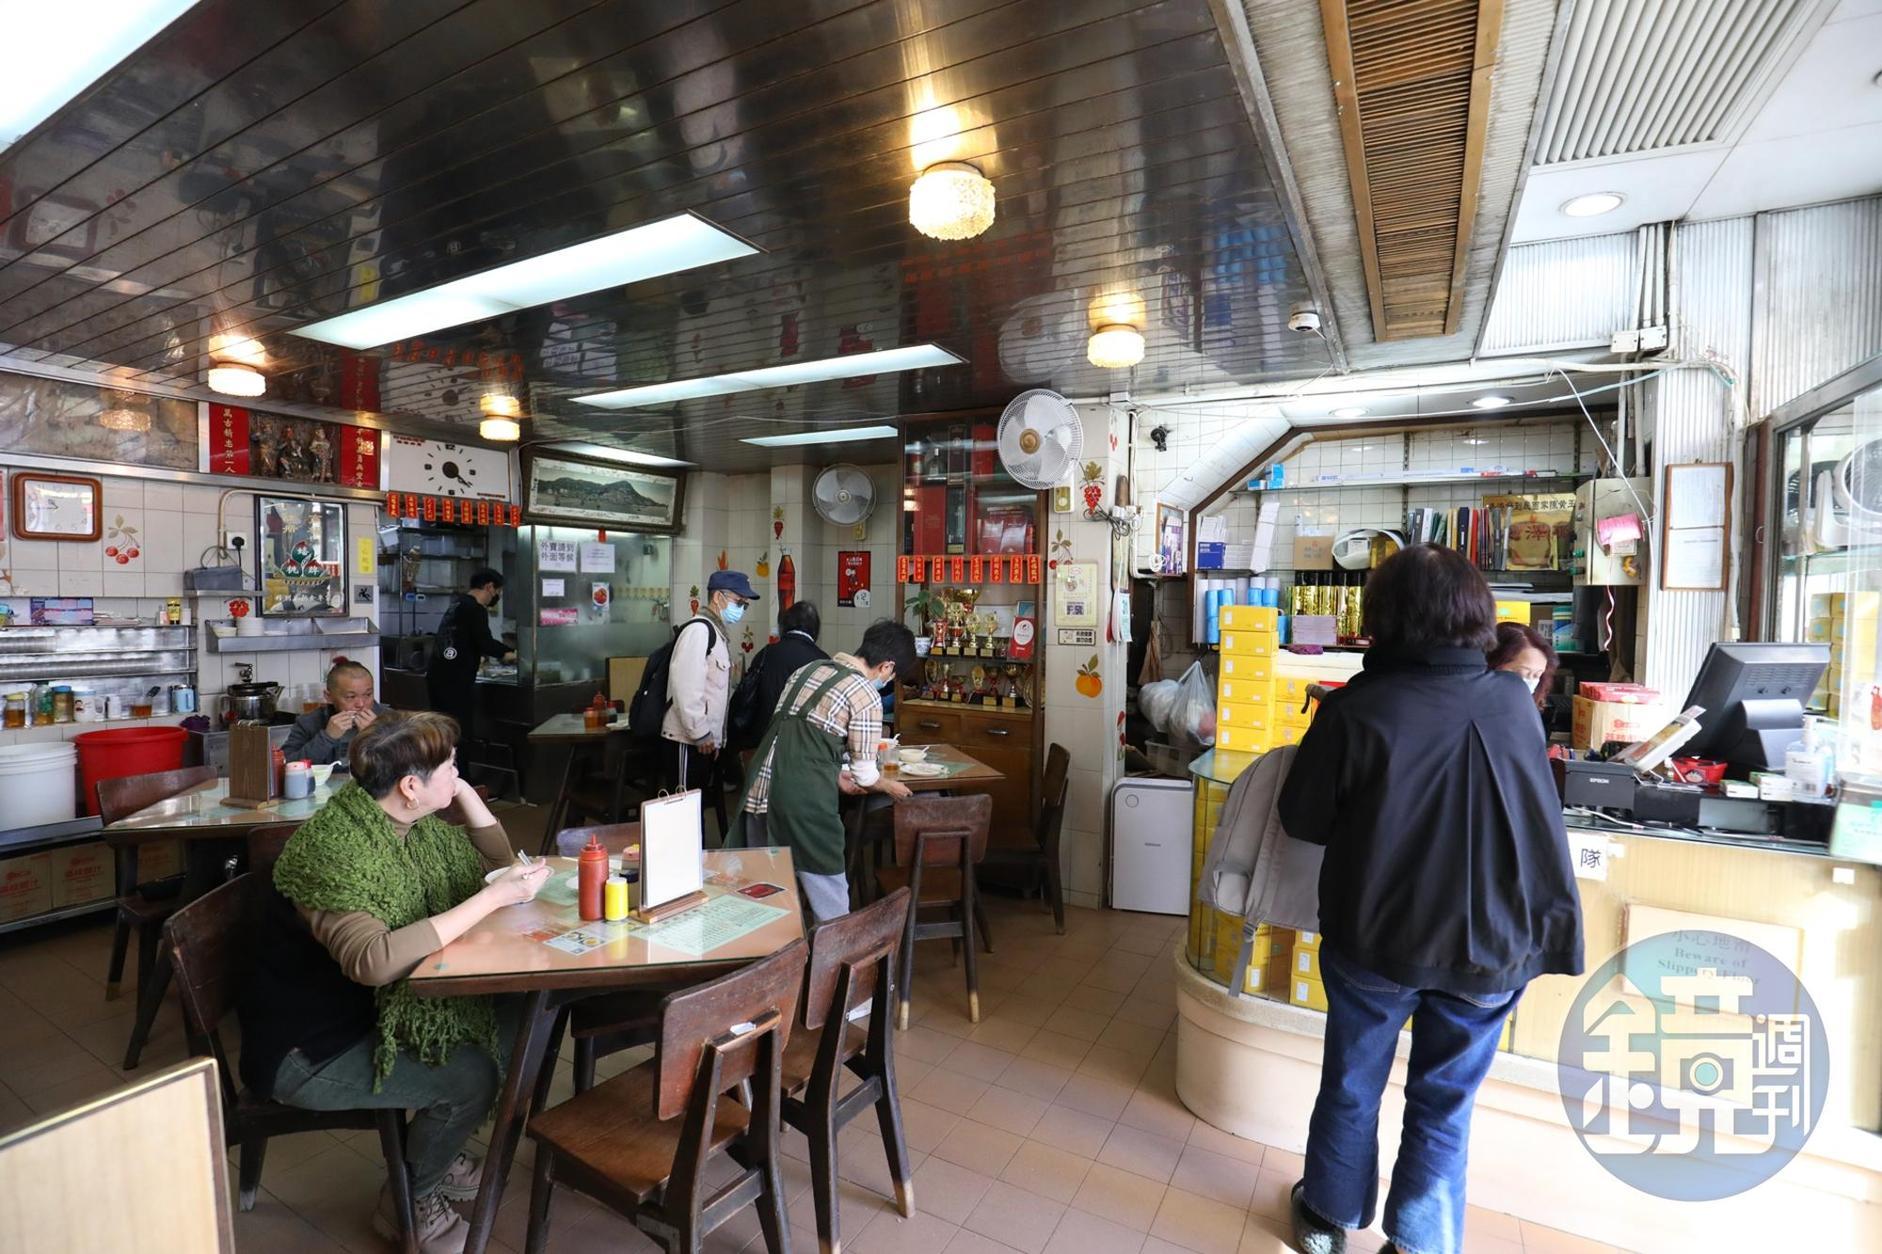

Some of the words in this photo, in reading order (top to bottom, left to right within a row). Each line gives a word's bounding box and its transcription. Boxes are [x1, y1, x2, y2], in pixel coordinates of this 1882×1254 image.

[541, 552, 575, 562] 外面等候
[1581, 848, 1600, 868] 隊
[1674, 947, 1726, 965] Beware
[1731, 958, 1748, 969] of
[1657, 958, 1720, 980] Slipp
